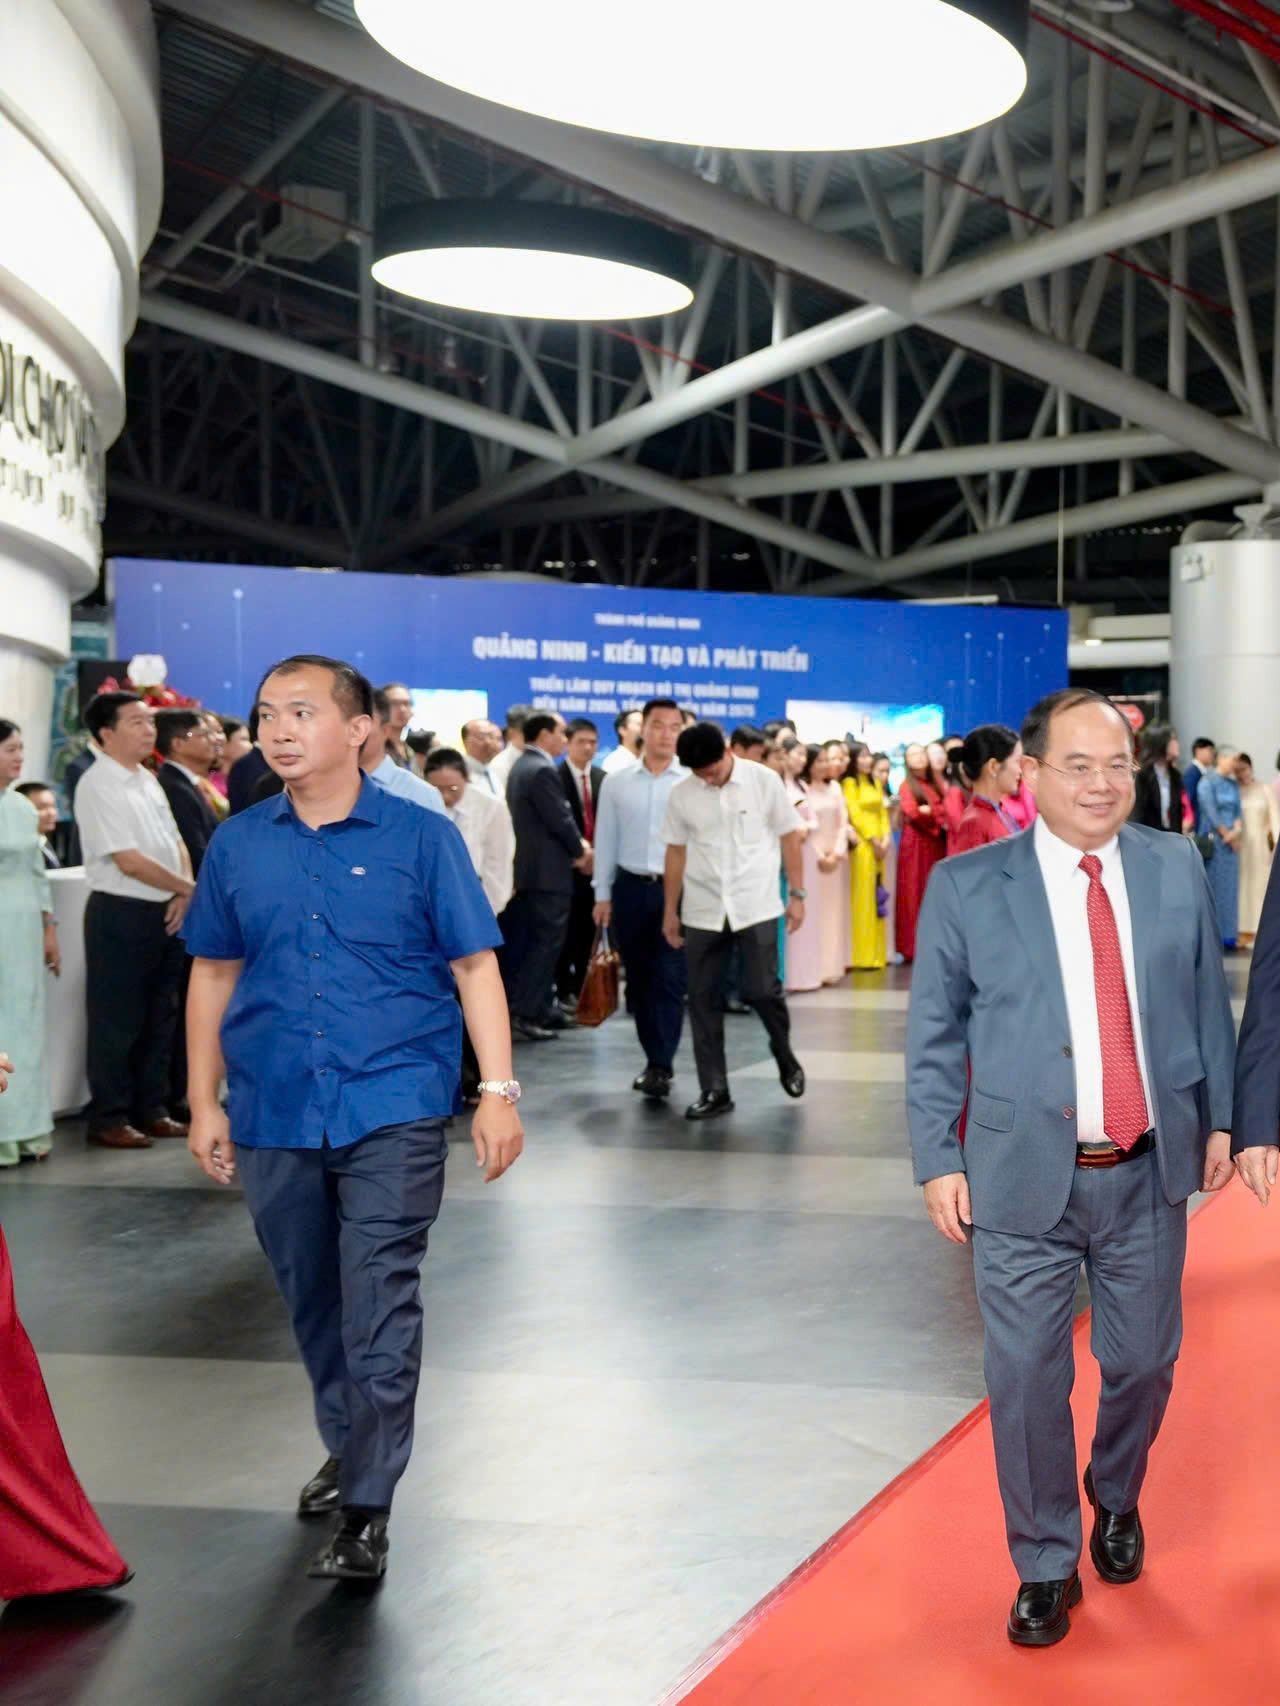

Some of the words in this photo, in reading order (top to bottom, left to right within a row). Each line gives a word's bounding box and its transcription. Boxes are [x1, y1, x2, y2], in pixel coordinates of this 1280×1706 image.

[473, 632, 538, 660] QUẢNG
[541, 639, 588, 662] NINH
[604, 638, 646, 665] KIẾN
[651, 645, 684, 670] TẠO
[687, 644, 711, 668] VÀ
[713, 646, 757, 670] PHÁT
[760, 645, 809, 672] TRIỂN
